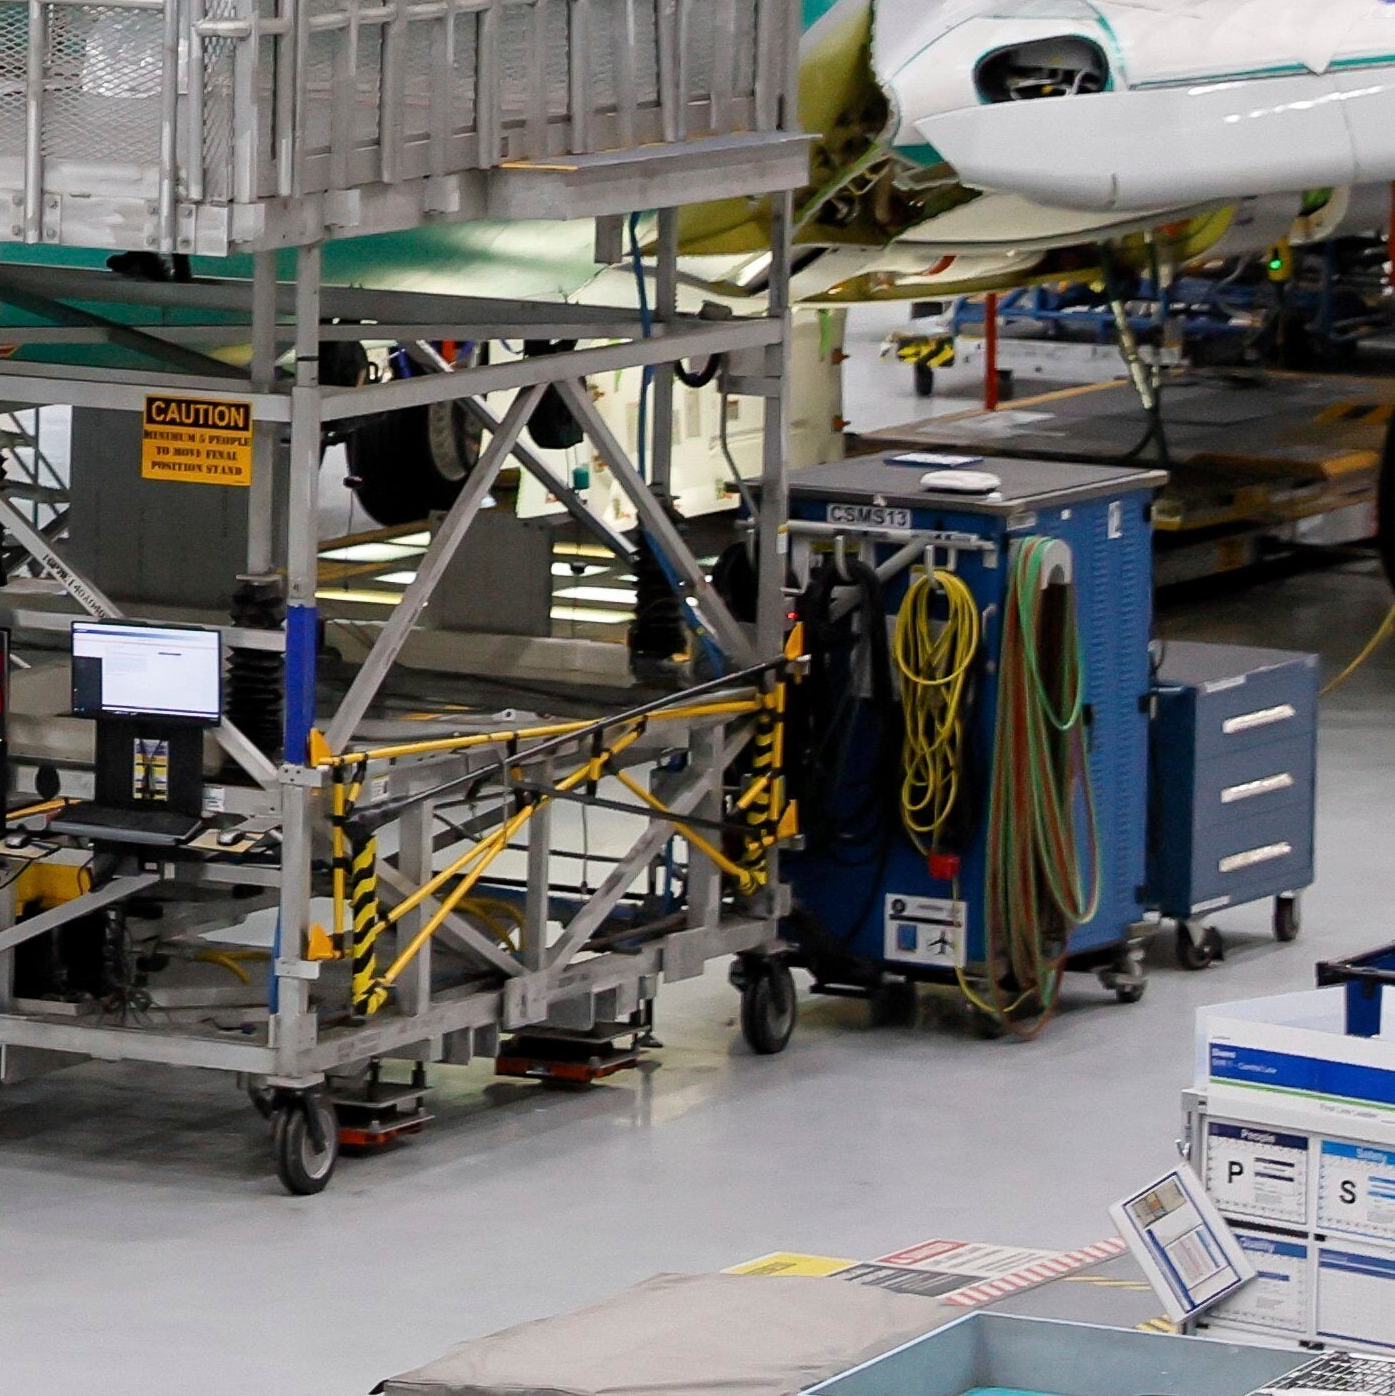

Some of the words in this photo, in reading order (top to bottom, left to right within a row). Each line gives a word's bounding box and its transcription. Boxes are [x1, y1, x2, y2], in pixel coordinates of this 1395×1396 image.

[151, 401, 245, 428] CAUTION
[155, 445, 169, 455] TO
[151, 460, 203, 473] POSITION
[206, 464, 243, 476] STAND
[830, 505, 908, 528] CSMS13
[1228, 1161, 1244, 1184] P
[1339, 1179, 1356, 1205] S
